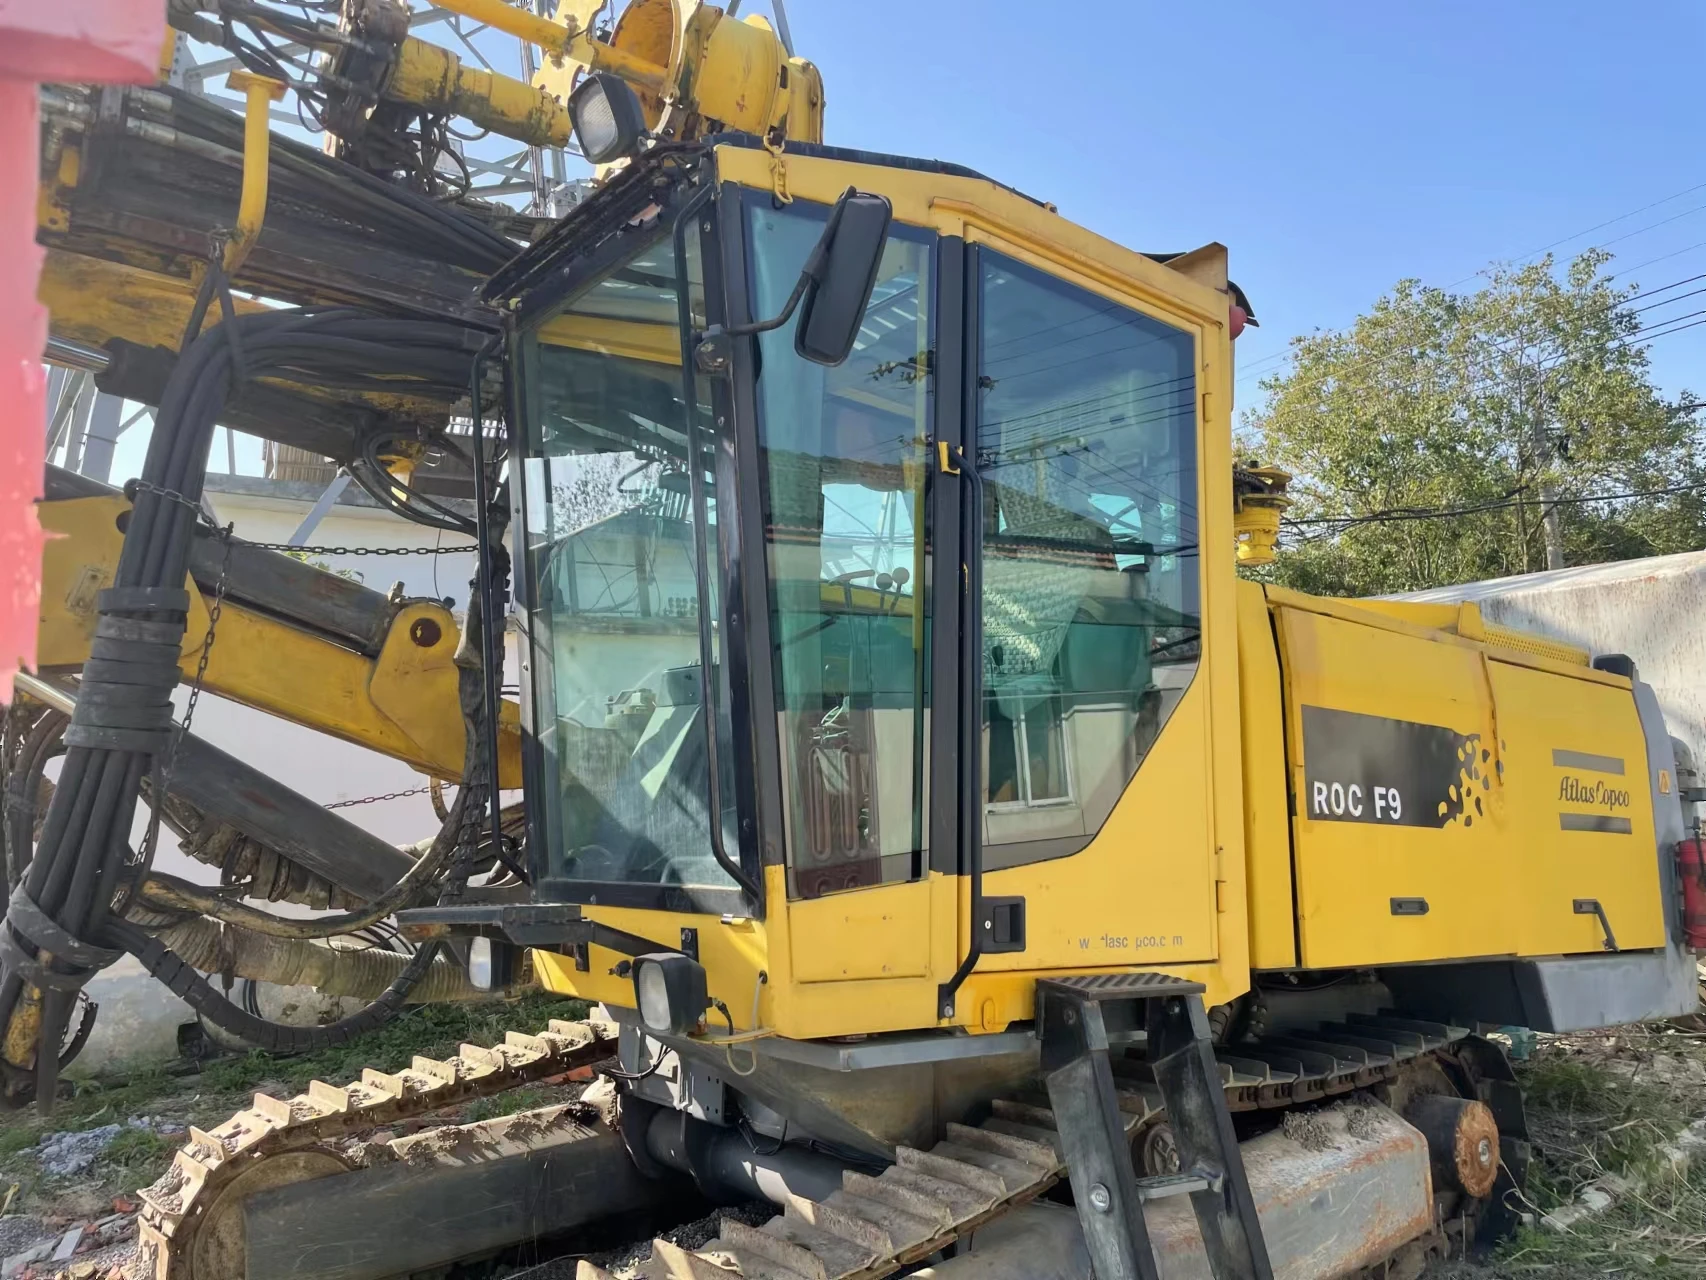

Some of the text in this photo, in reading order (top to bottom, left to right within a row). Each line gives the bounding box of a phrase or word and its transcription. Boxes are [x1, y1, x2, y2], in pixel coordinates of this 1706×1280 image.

[1313, 780, 1402, 820] ROC F9
[1558, 776, 1630, 811] Atlas Copco
